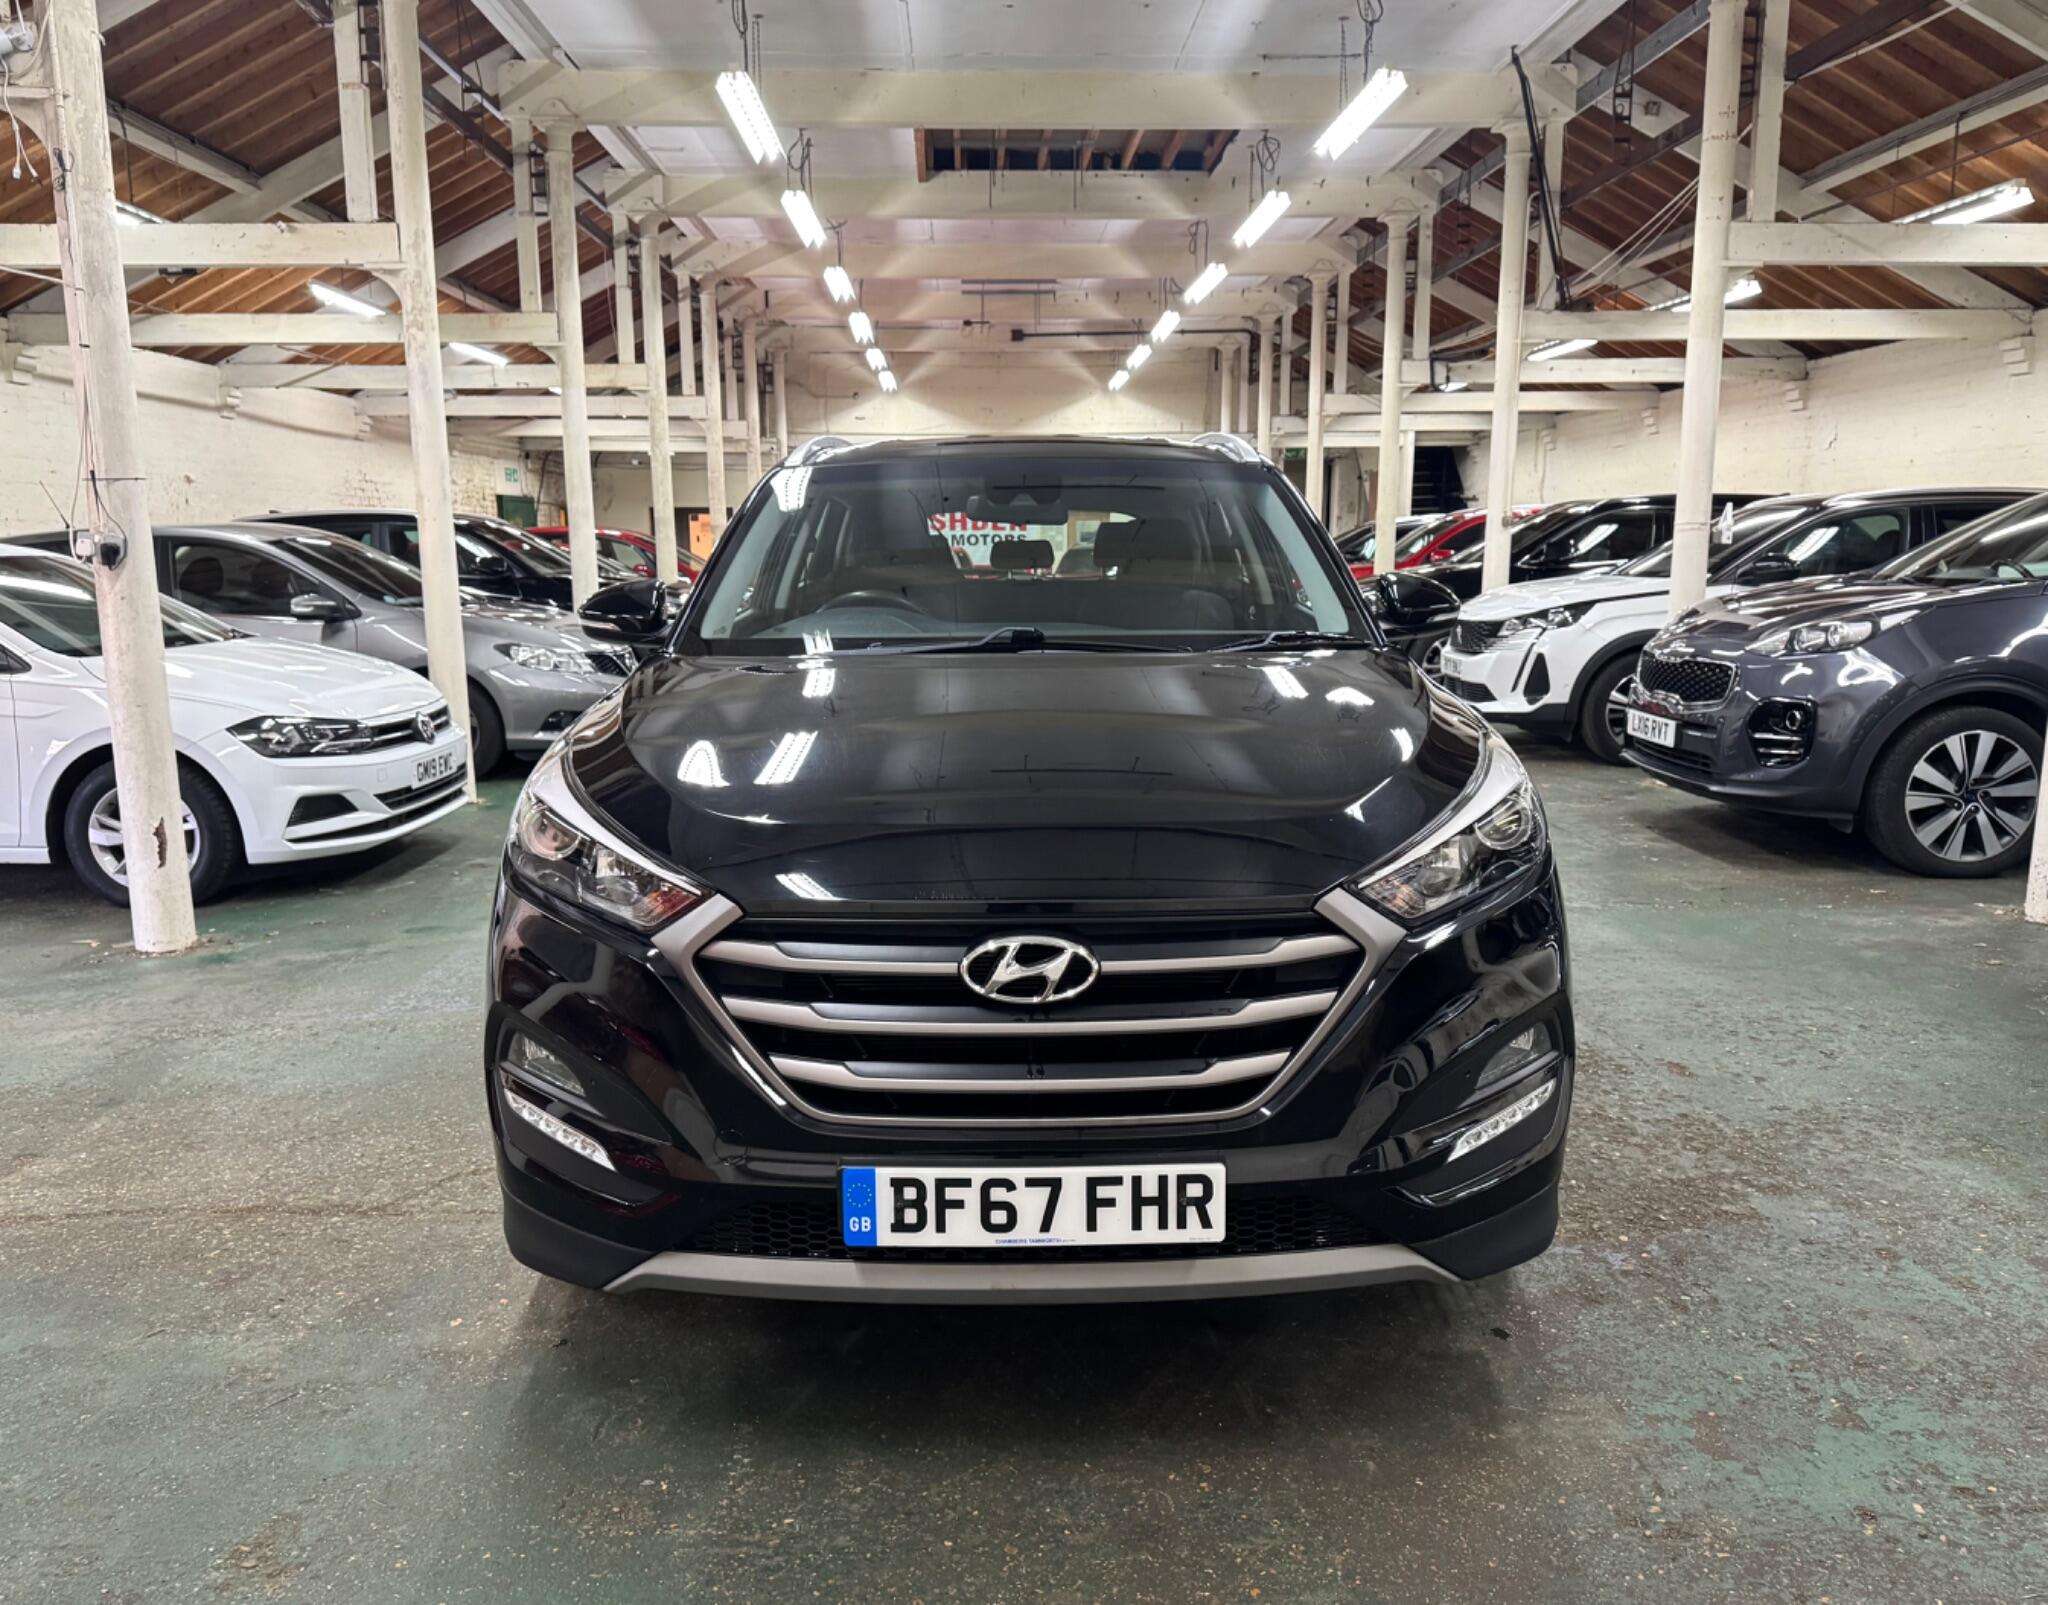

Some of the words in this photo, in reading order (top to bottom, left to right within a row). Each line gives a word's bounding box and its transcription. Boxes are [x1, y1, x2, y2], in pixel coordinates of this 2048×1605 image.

[951, 533, 1027, 546] MOTORS
[889, 1176, 1063, 1234] BF67
[1086, 1173, 1214, 1232] FHR
[849, 1216, 872, 1232] GB
